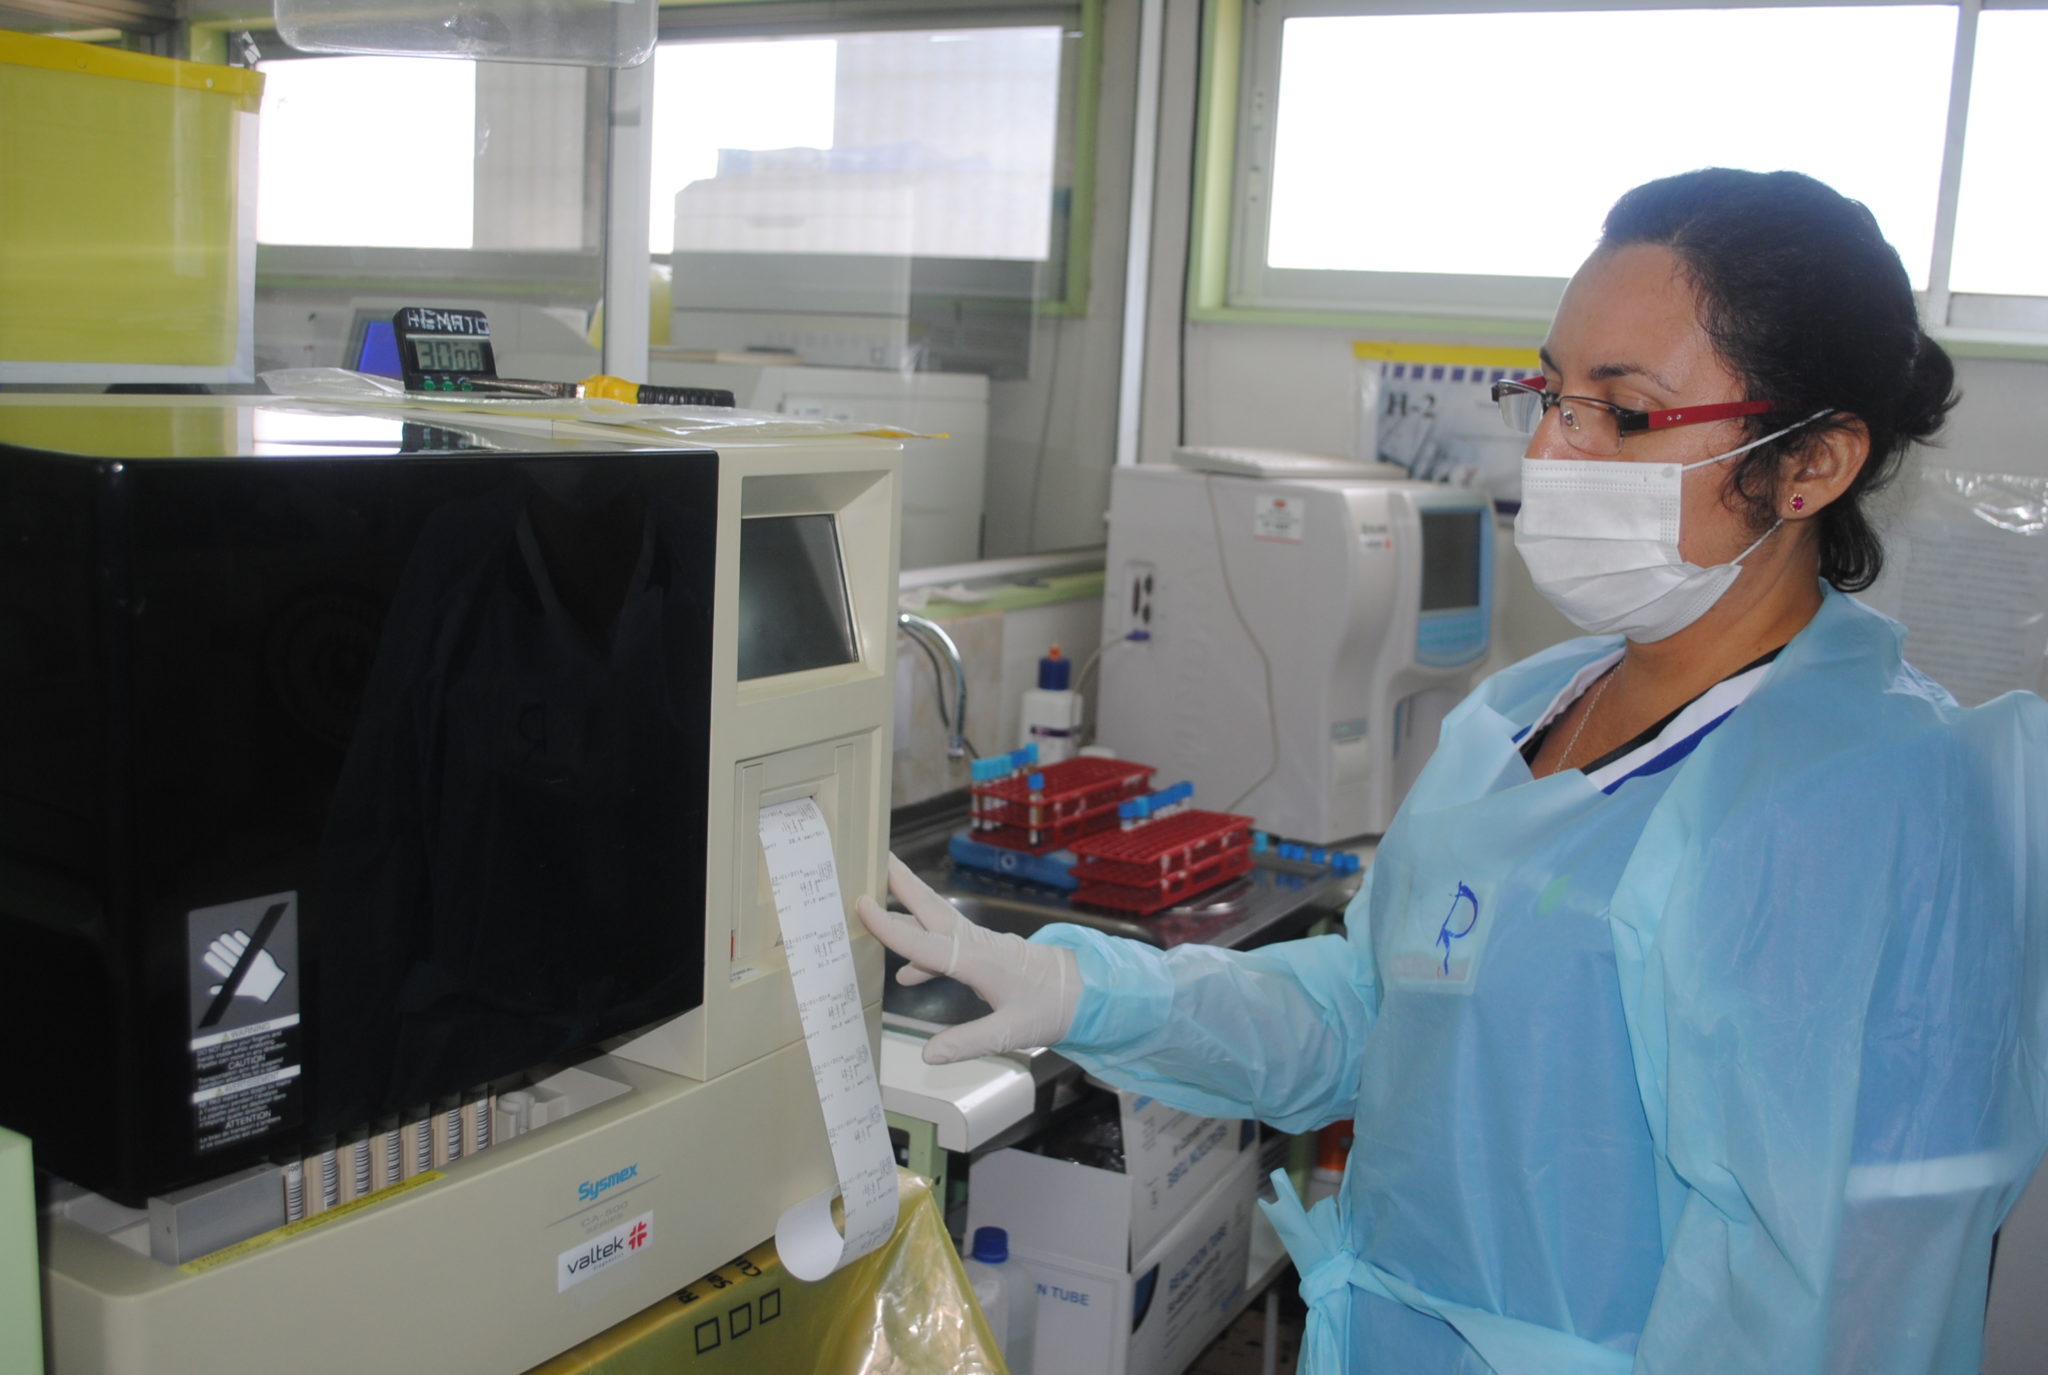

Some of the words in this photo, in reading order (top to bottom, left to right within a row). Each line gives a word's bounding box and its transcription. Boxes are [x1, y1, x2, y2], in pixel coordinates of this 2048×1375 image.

[227, 1053, 266, 1070] CAUTION
[225, 1109, 271, 1130] ATTENTION
[577, 1163, 638, 1201] Sysmex
[567, 1236, 624, 1274] valtek
[1051, 1285, 1089, 1306] TUBE
